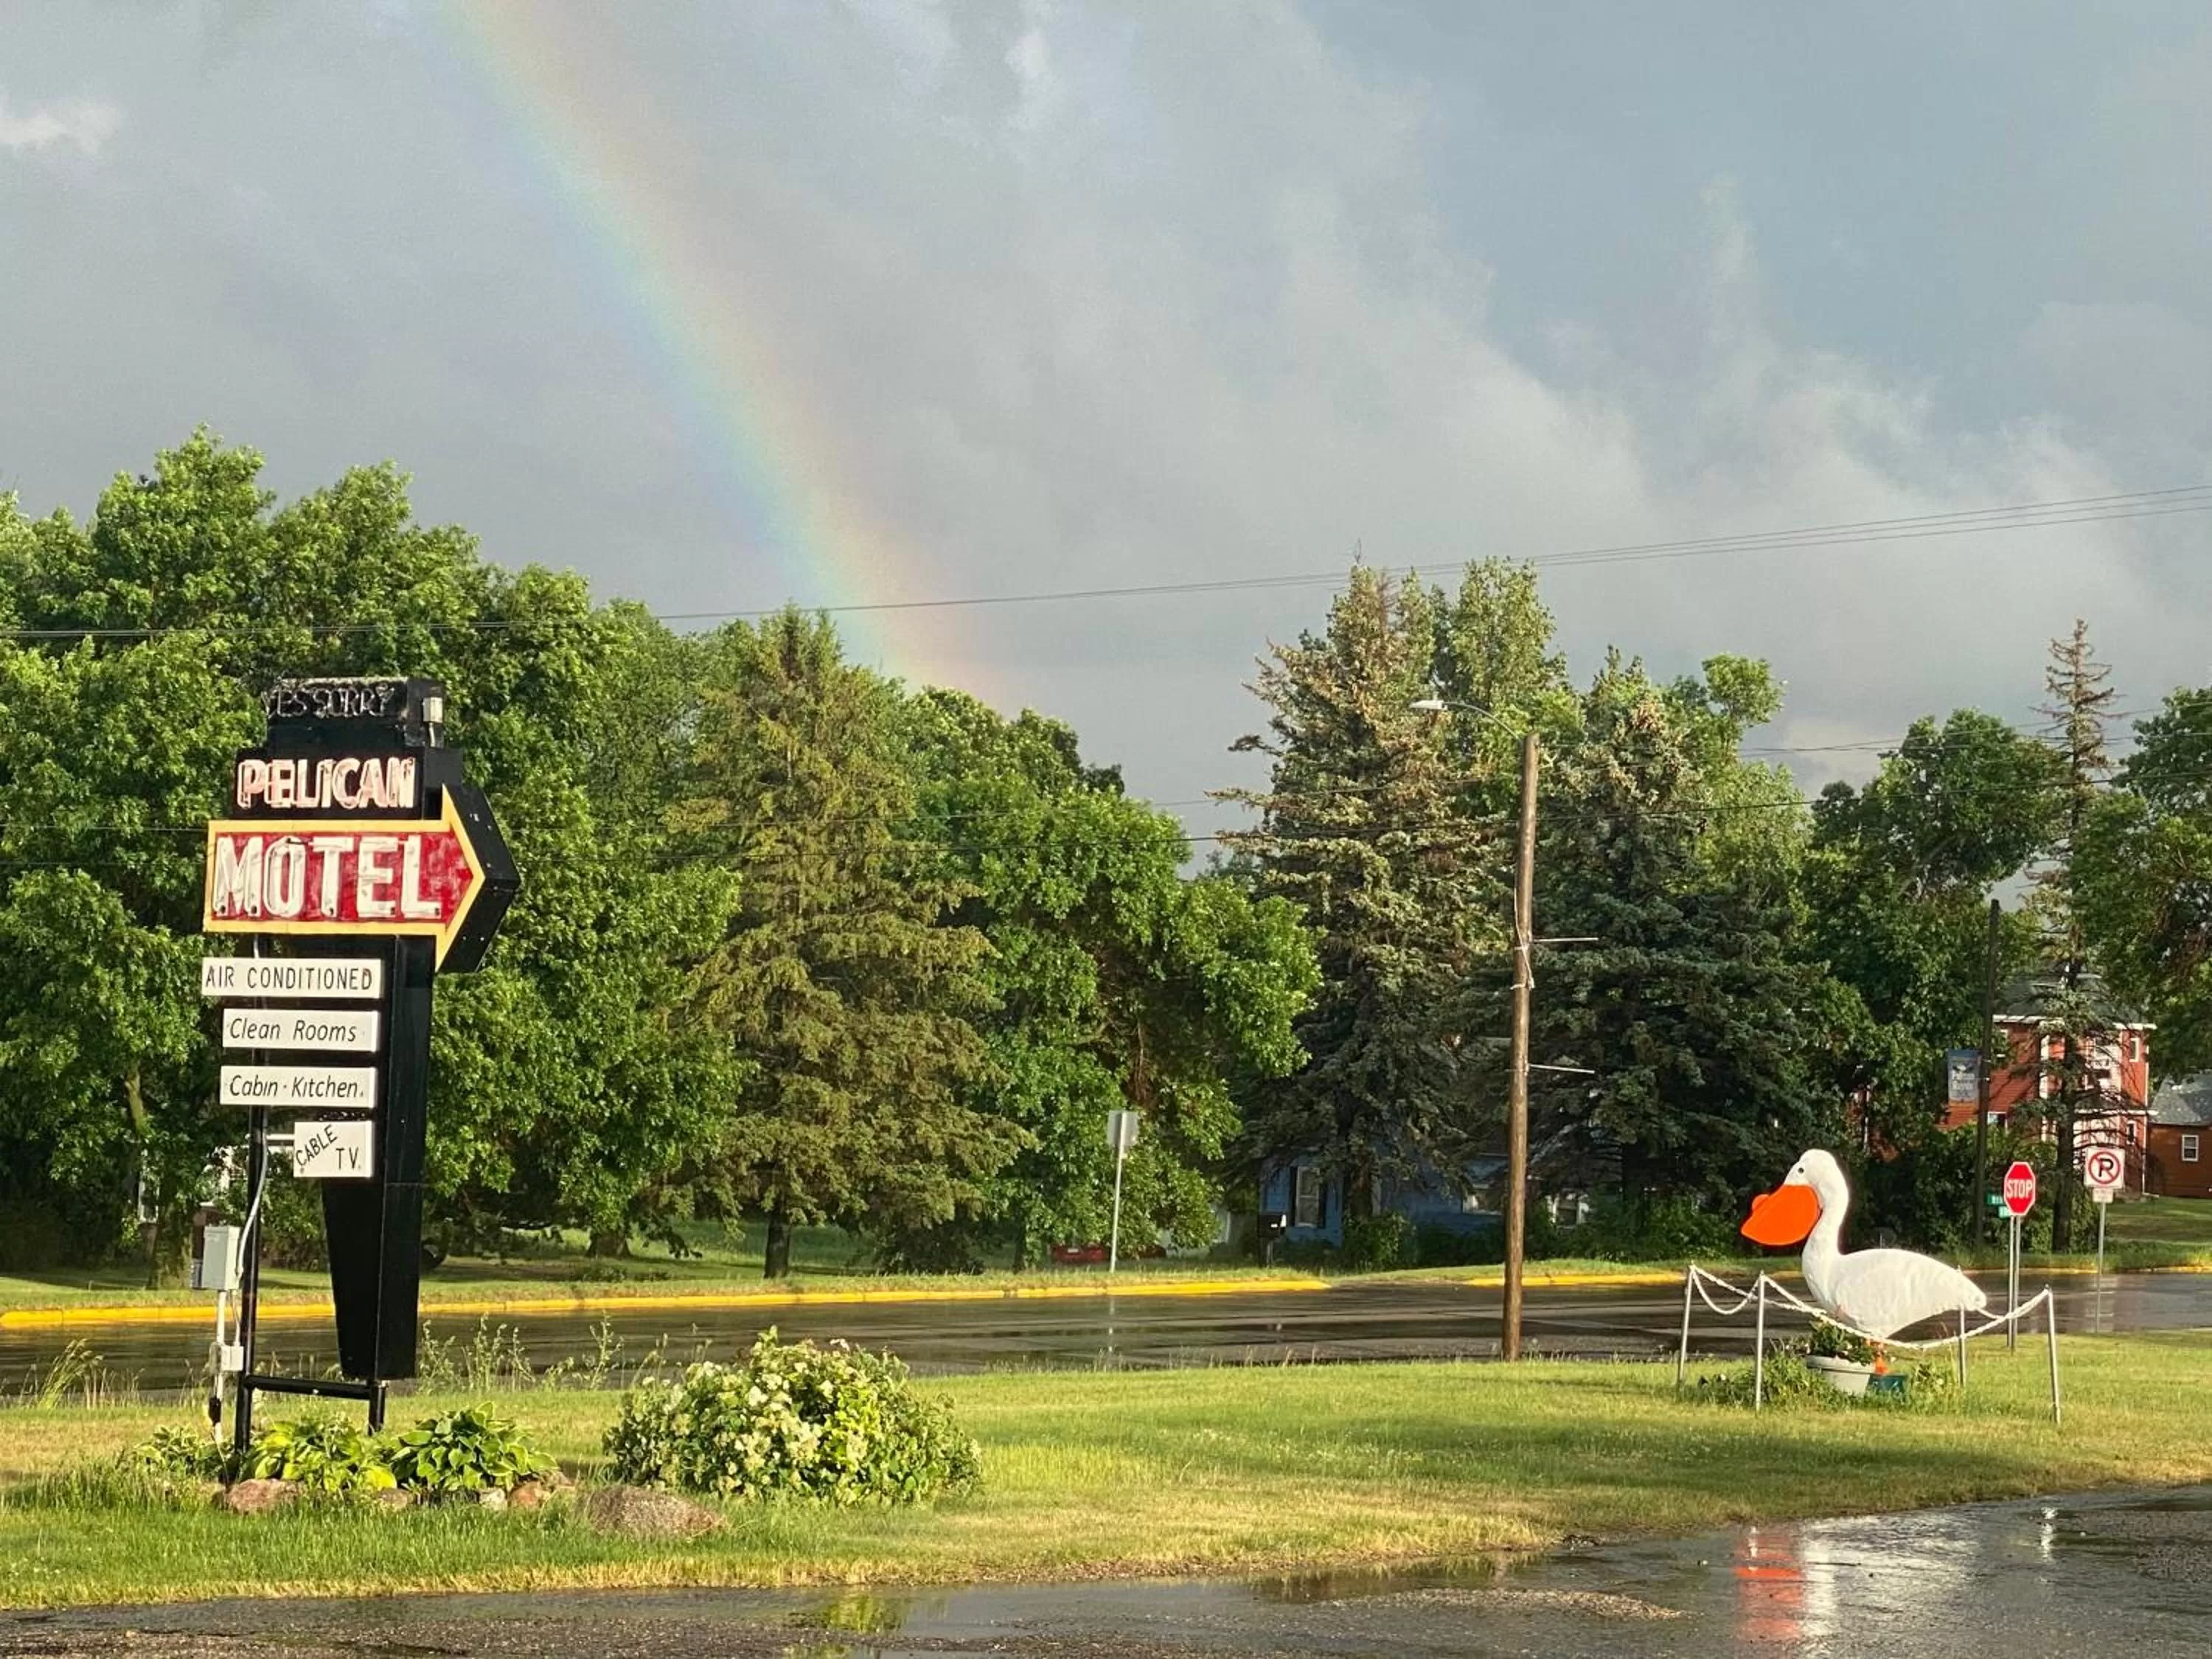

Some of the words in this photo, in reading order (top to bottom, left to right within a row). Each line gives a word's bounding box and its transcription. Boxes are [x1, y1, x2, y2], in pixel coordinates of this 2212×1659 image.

[313, 684, 395, 718] SORRY
[237, 757, 417, 809] PELICAN
[213, 835, 442, 919] MOTEL
[205, 965, 235, 988] AIR
[247, 967, 372, 990] CONDITIONED
[230, 1018, 281, 1040] Clean
[293, 1020, 357, 1043] Rooms
[230, 1074, 278, 1097] Cabin
[296, 1124, 338, 1166] CABLE
[2006, 1179, 2033, 1199] STOP
